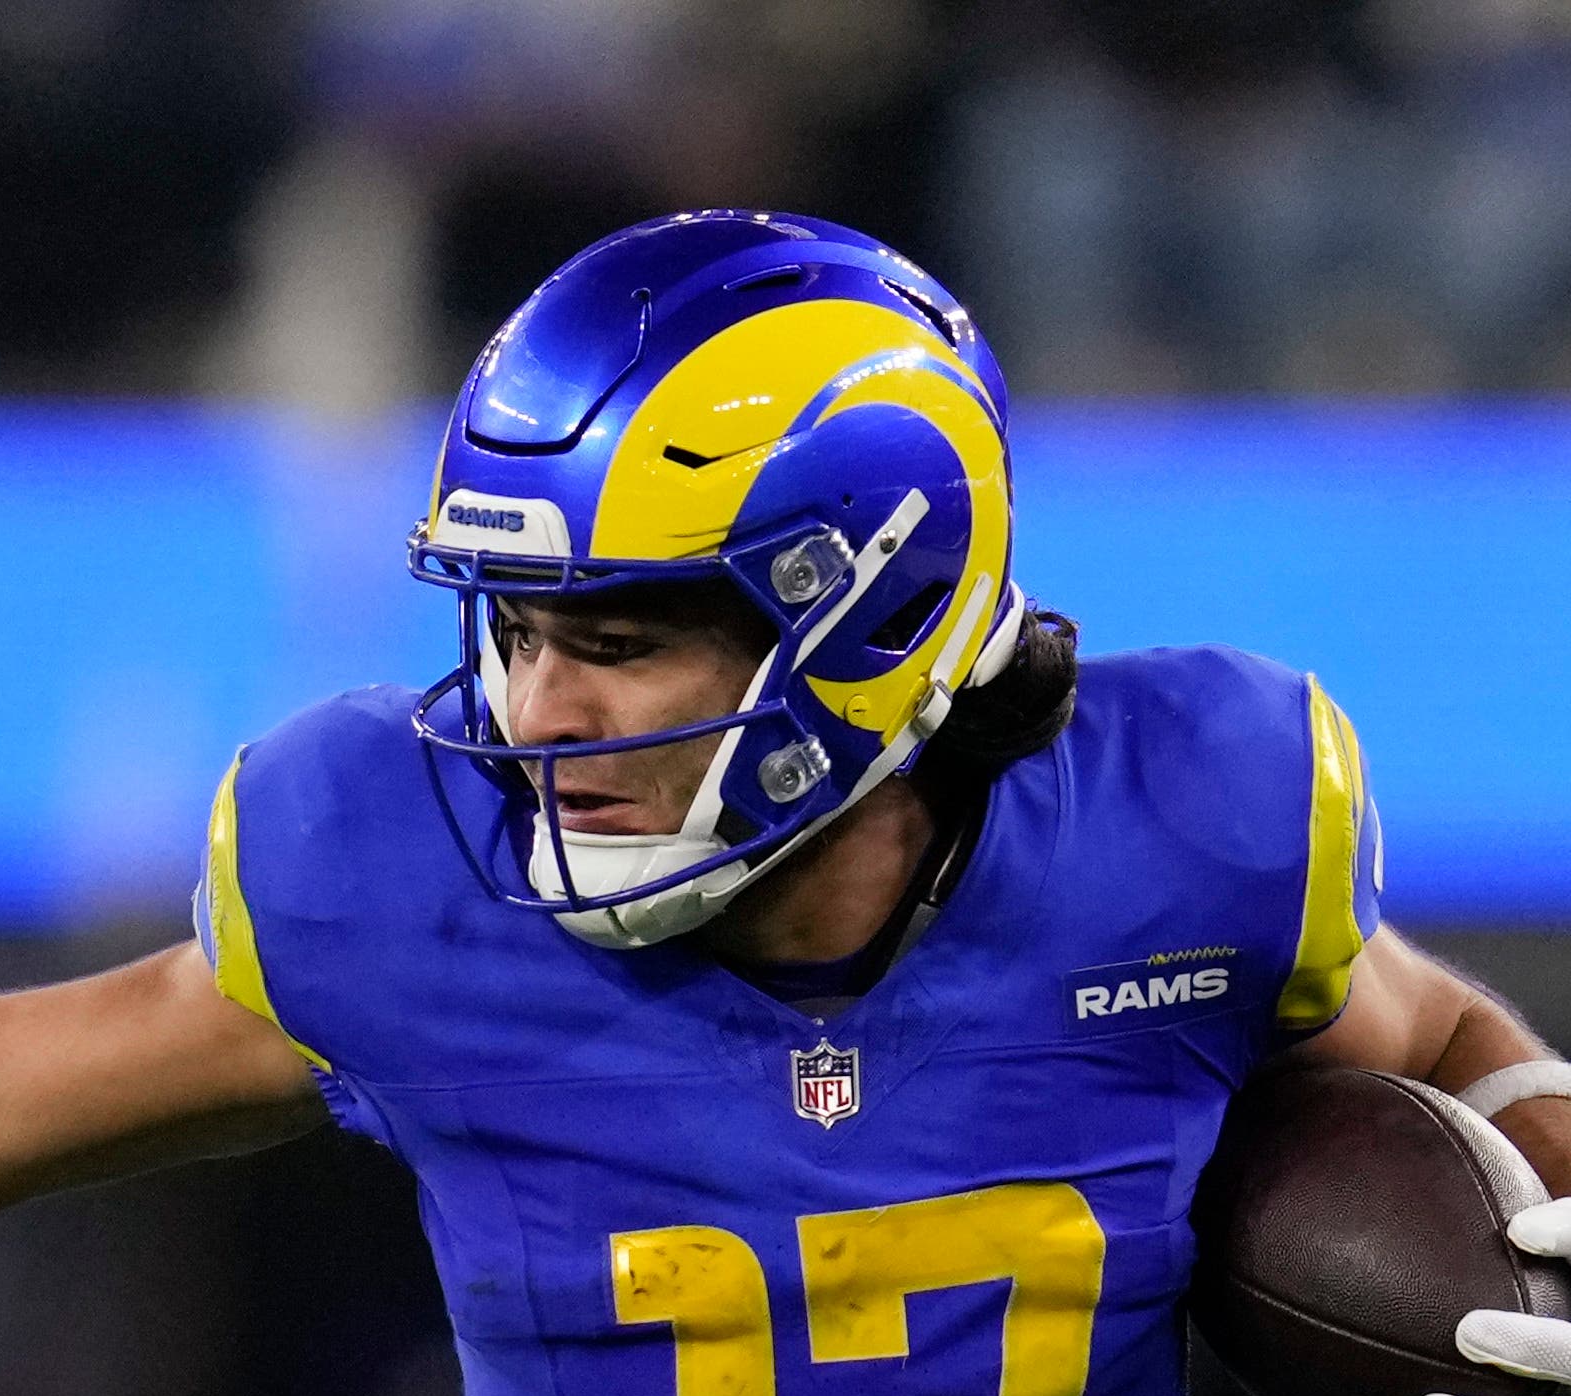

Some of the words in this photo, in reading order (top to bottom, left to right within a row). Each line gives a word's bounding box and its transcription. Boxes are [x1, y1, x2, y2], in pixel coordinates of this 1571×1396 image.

[447, 503, 525, 532] RAMS
[1075, 967, 1229, 1020] RAMS
[803, 1079, 850, 1113] NFL
